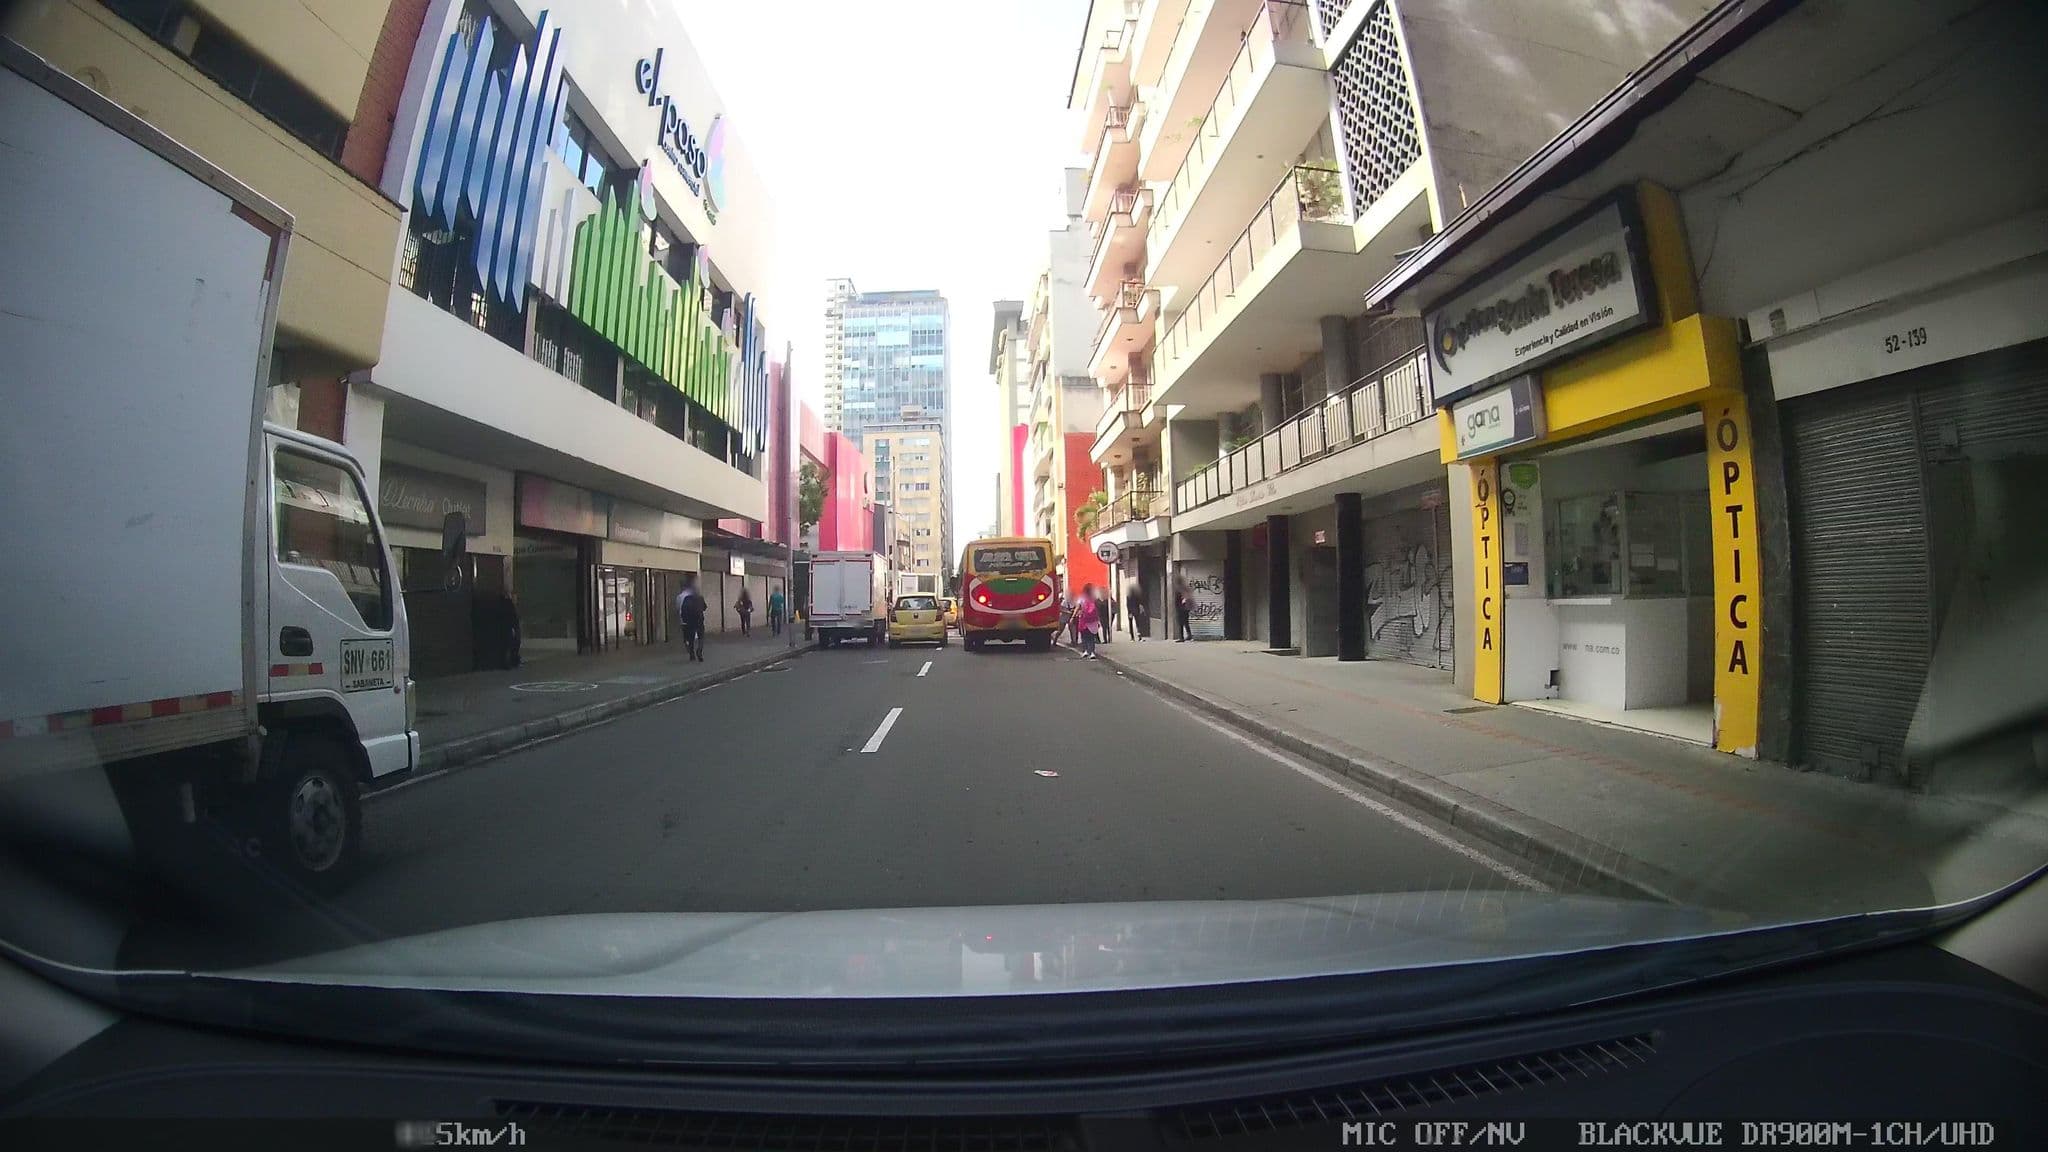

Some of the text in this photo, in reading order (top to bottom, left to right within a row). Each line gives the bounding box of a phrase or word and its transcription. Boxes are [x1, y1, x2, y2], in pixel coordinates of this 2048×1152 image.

[1514, 331, 1549, 357] Experiencia
[1553, 319, 1579, 339] Calidad
[1579, 319, 1590, 328] en
[1588, 305, 1614, 325] Visión
[1884, 326, 1928, 354] 52-139
[1467, 404, 1501, 439] gana
[1475, 469, 1493, 651] ÓPTICA
[1715, 406, 1749, 675] ÓPTICA
[343, 649, 391, 675] SNV 661
